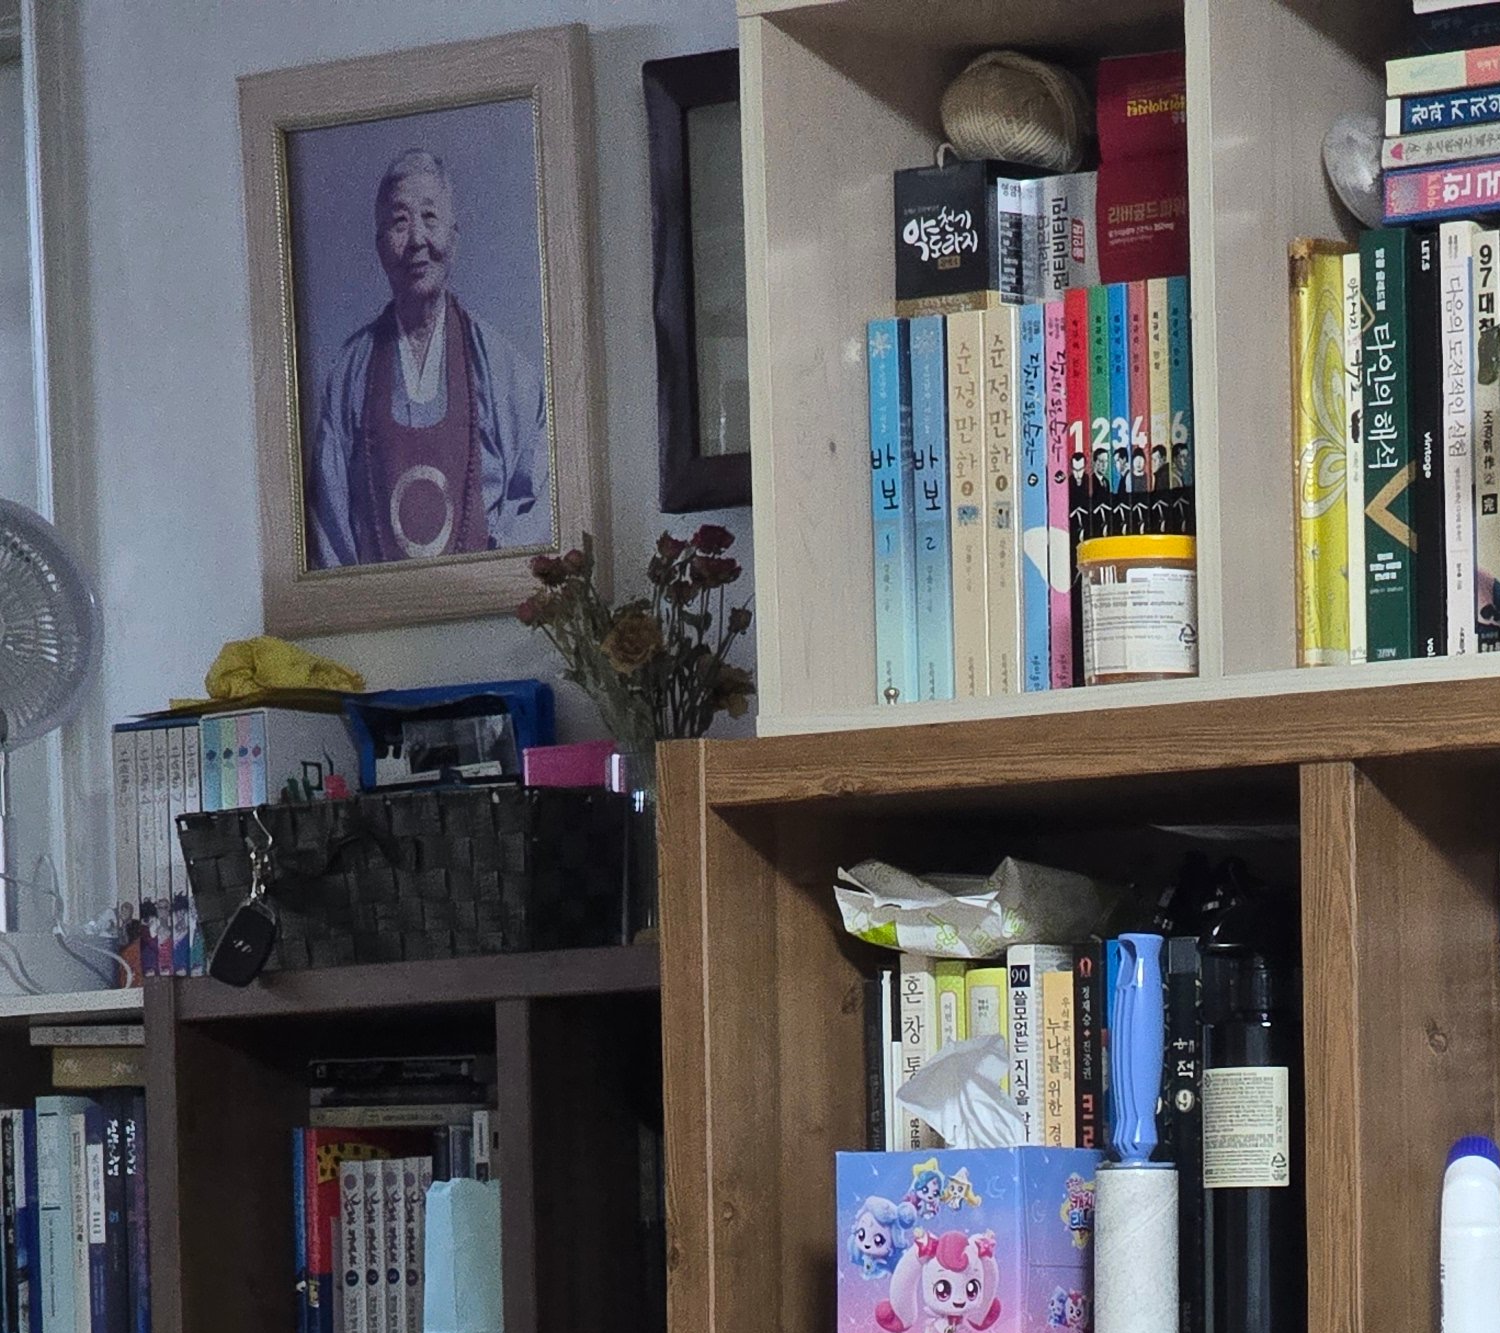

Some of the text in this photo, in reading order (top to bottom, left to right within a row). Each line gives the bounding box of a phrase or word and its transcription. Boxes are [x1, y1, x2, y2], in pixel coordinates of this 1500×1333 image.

[952, 340, 977, 480] 순정만화
[985, 333, 1010, 474] 순정만화
[1366, 322, 1398, 469] 타인의 해석
[1069, 421, 1084, 446] 1
[1092, 418, 1110, 445] 2
[1112, 417, 1130, 444] 3
[1131, 416, 1148, 444] 4
[1171, 412, 1188, 441] 6
[1422, 431, 1432, 479] vintage
[870, 443, 899, 511] 바보
[914, 443, 942, 511] 바보
[1011, 988, 1030, 1105] 쓸모없는 지식을
